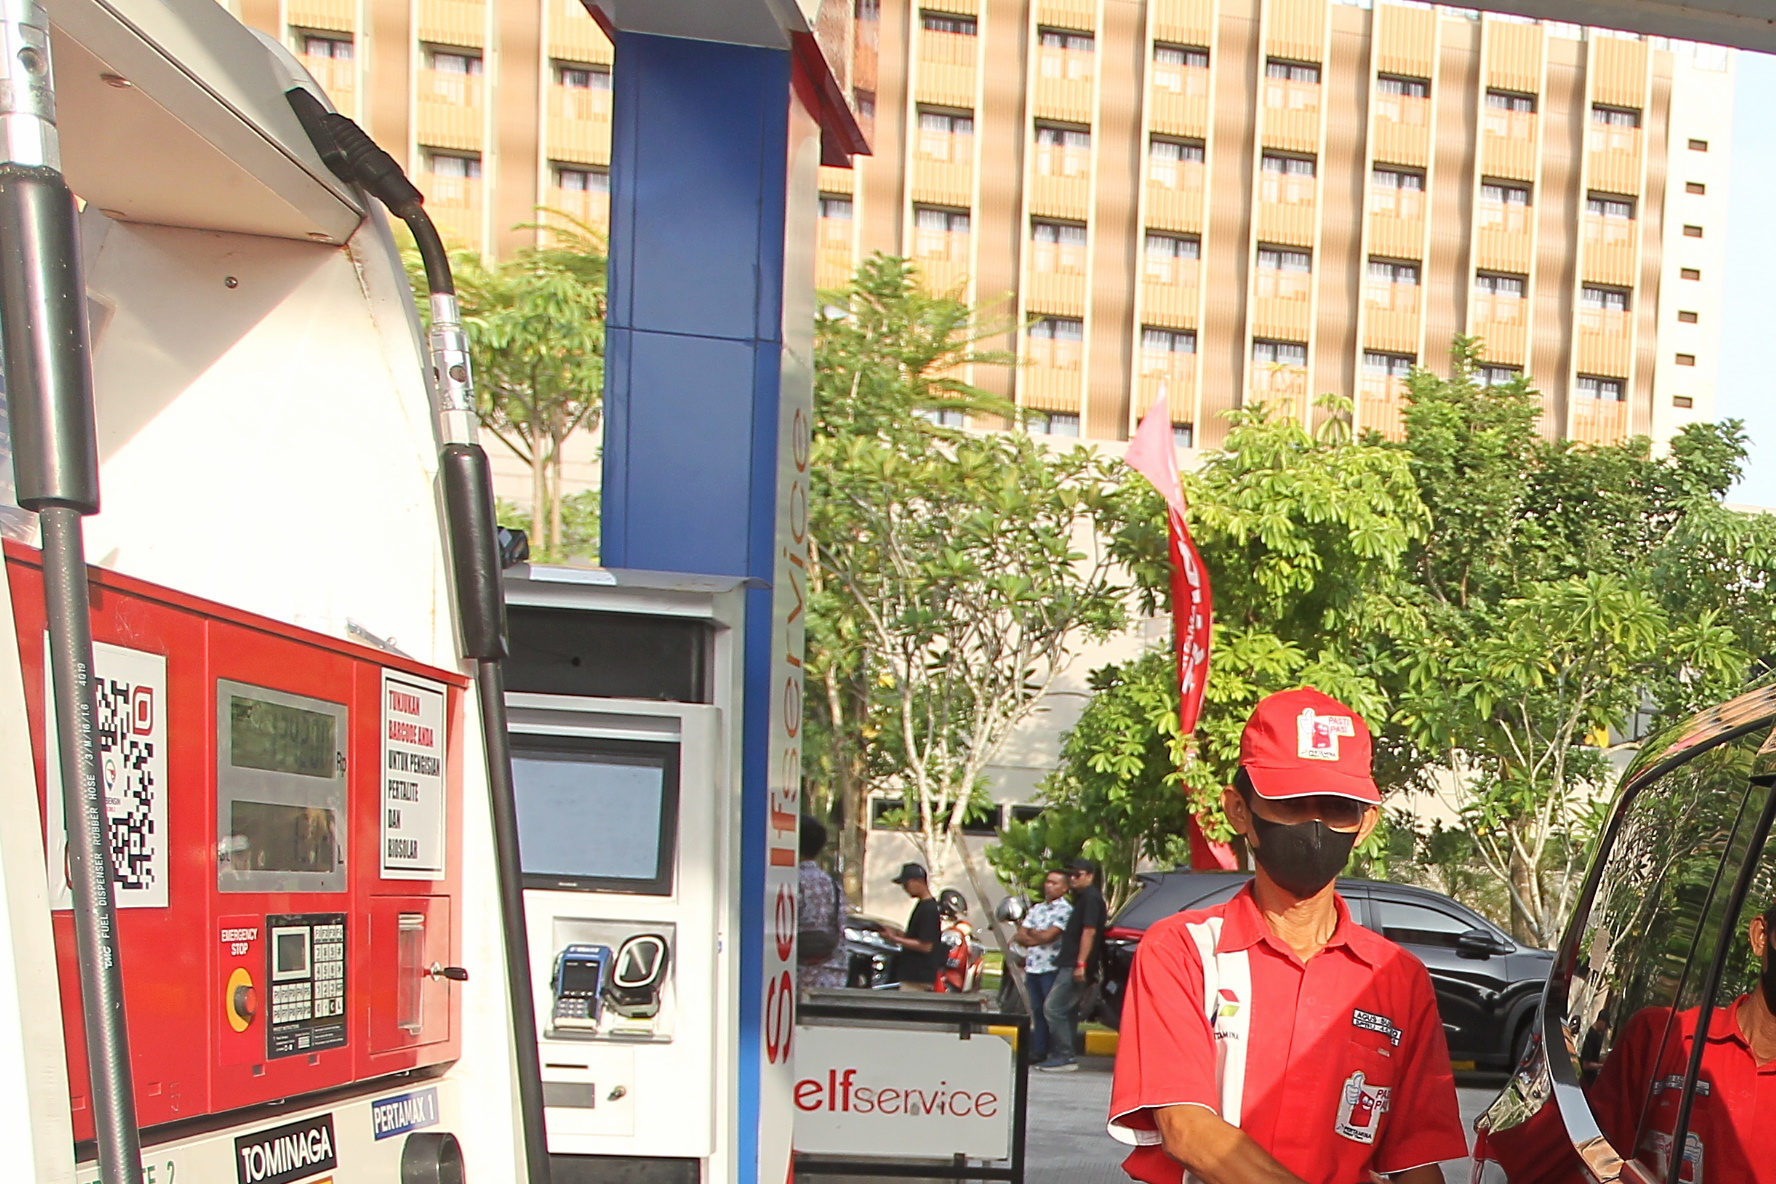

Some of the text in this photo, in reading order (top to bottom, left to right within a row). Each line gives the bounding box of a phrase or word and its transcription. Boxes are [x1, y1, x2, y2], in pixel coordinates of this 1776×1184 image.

[389, 720, 433, 747] BARCODE ANDA
[388, 749, 409, 772] UNTUK
[86, 774, 97, 800] HOSE
[388, 779, 418, 802] PERTALITE
[91, 807, 101, 845] RUBBER
[388, 809, 401, 829] DAN
[388, 838, 418, 860] BIOSOLAR
[95, 852, 109, 906] DISPENSER
[101, 913, 110, 939] FUEL
[221, 928, 258, 942] EMERGENCY
[231, 942, 249, 956] STOP
[793, 1069, 997, 1118] elfservice
[374, 1094, 434, 1134] PERTAMAX 1
[241, 1126, 333, 1184] TOMINAGA
